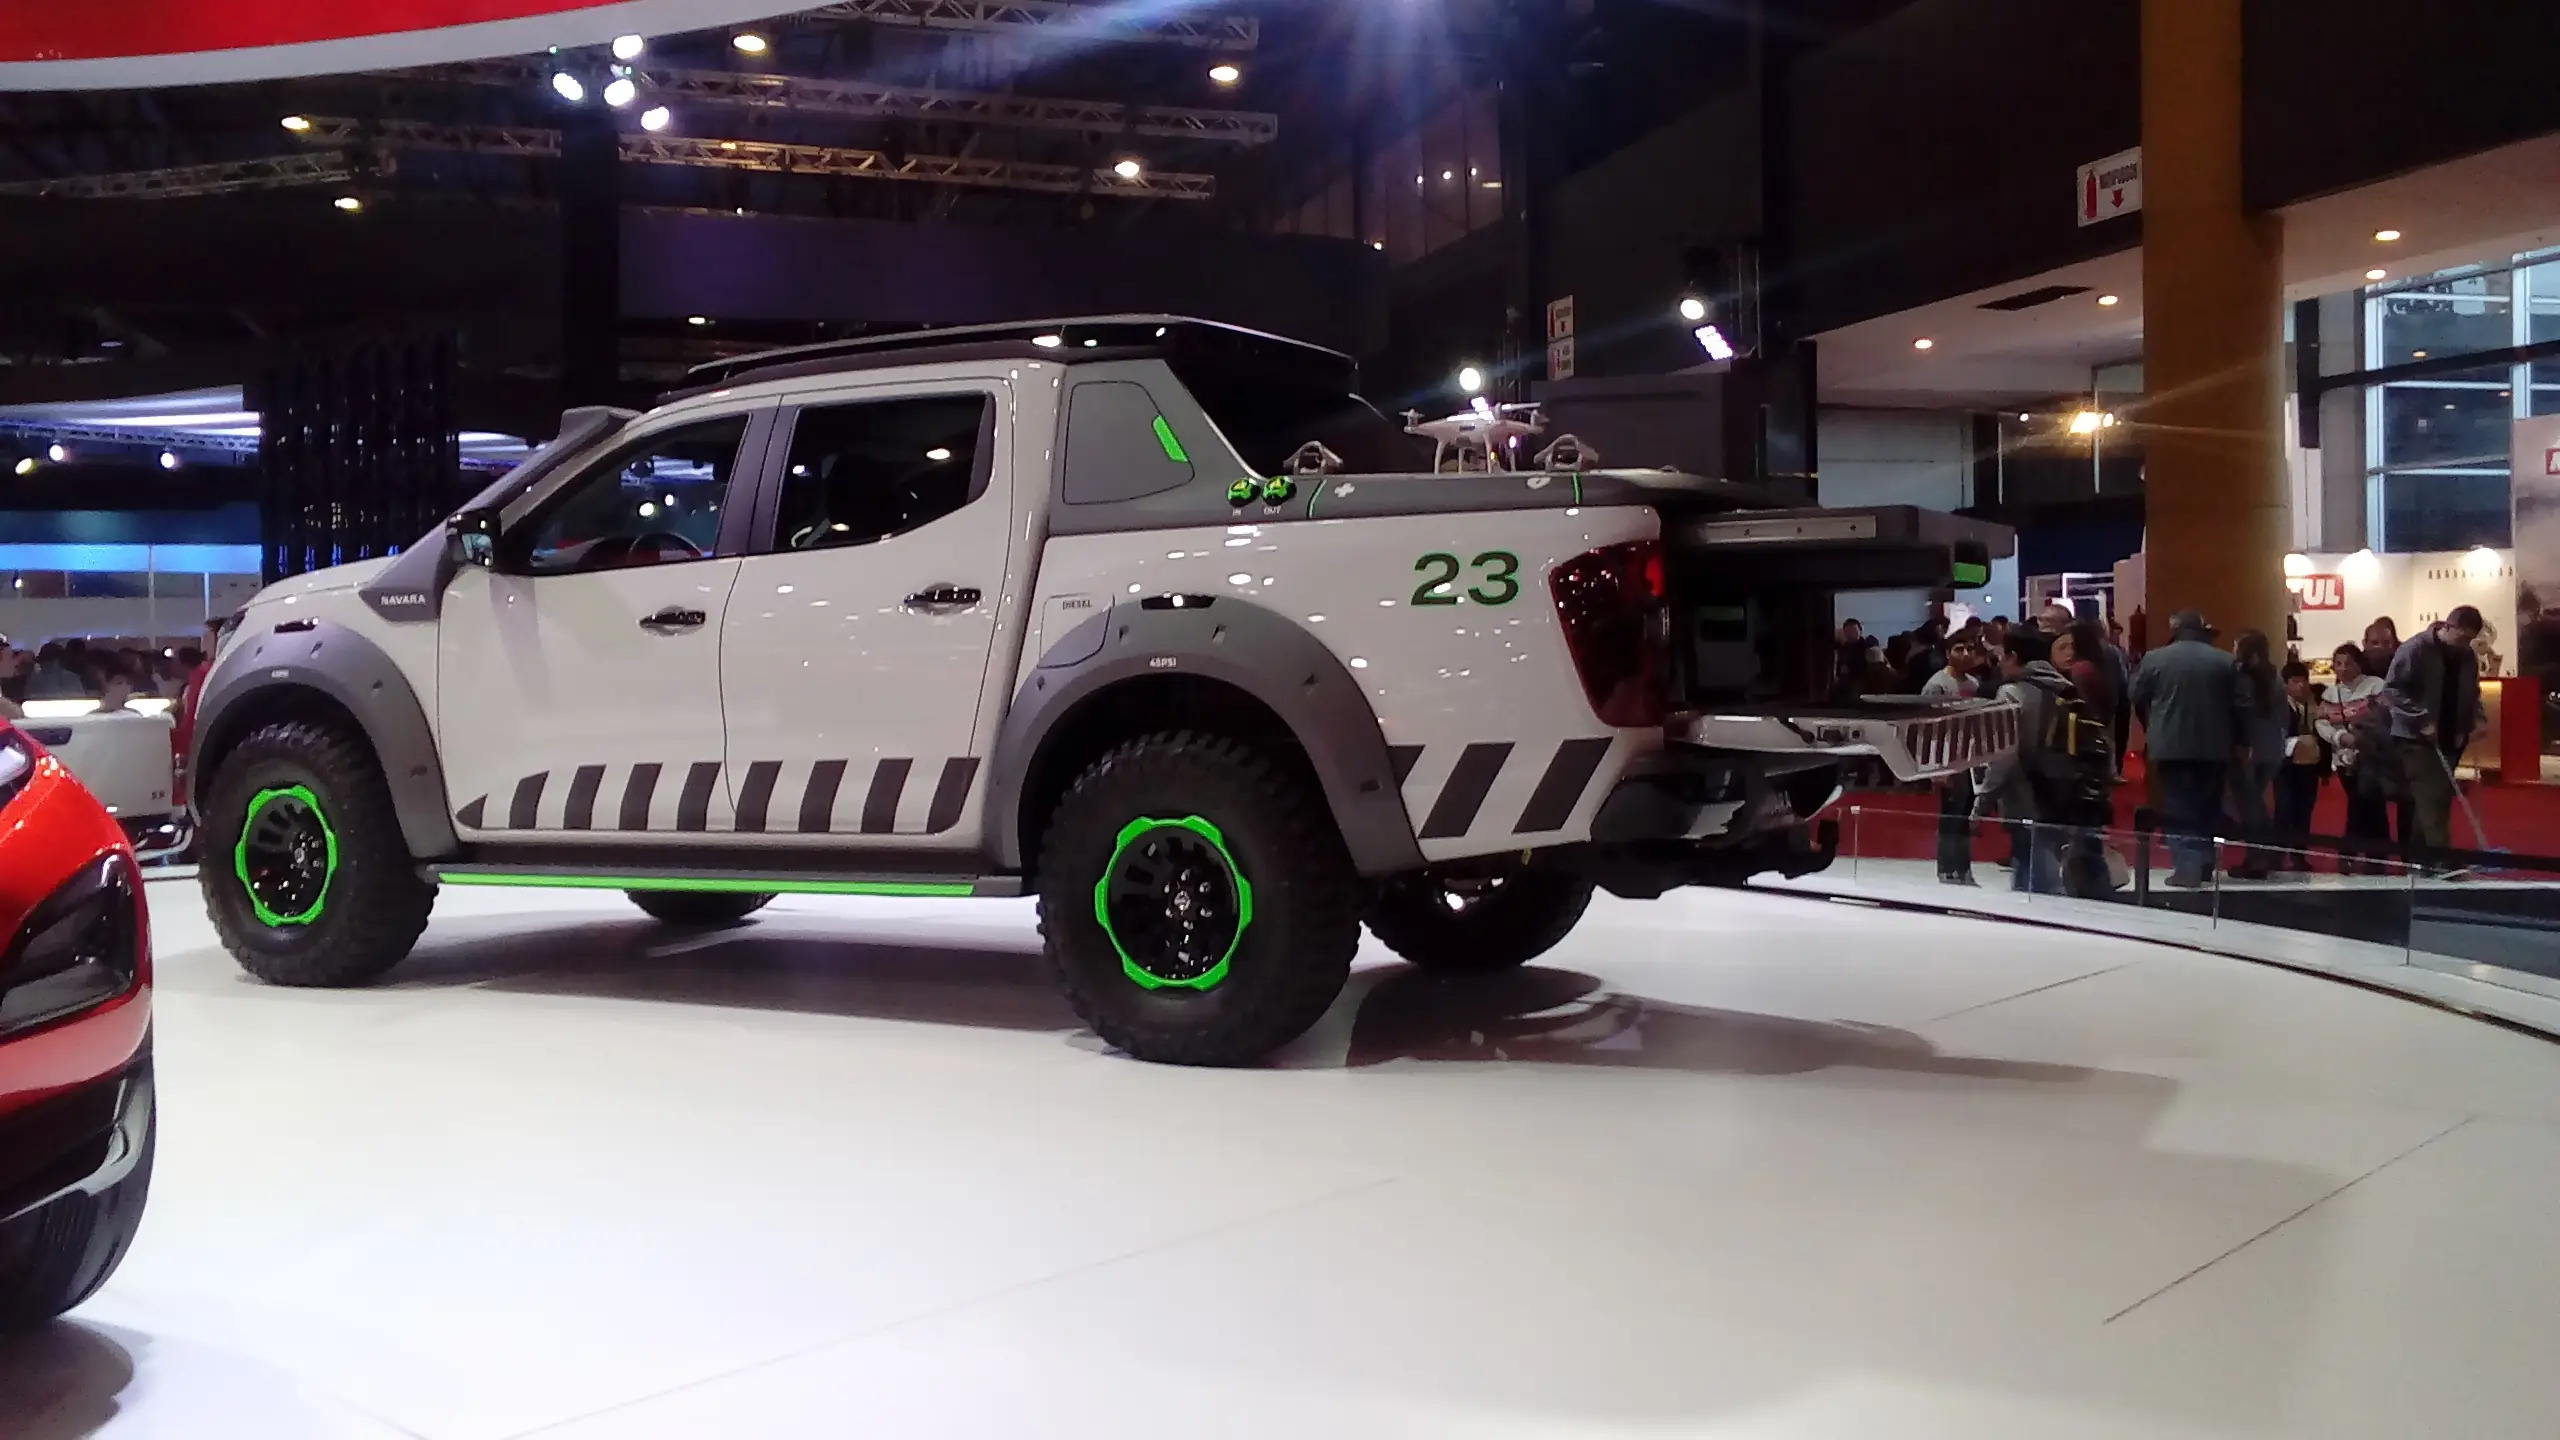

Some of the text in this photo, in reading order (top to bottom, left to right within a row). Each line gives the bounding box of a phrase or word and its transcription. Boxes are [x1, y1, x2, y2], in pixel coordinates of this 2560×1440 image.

[1410, 550, 1520, 607] 23
[380, 594, 427, 606] NAVARA
[1062, 600, 1092, 610] DIESEL
